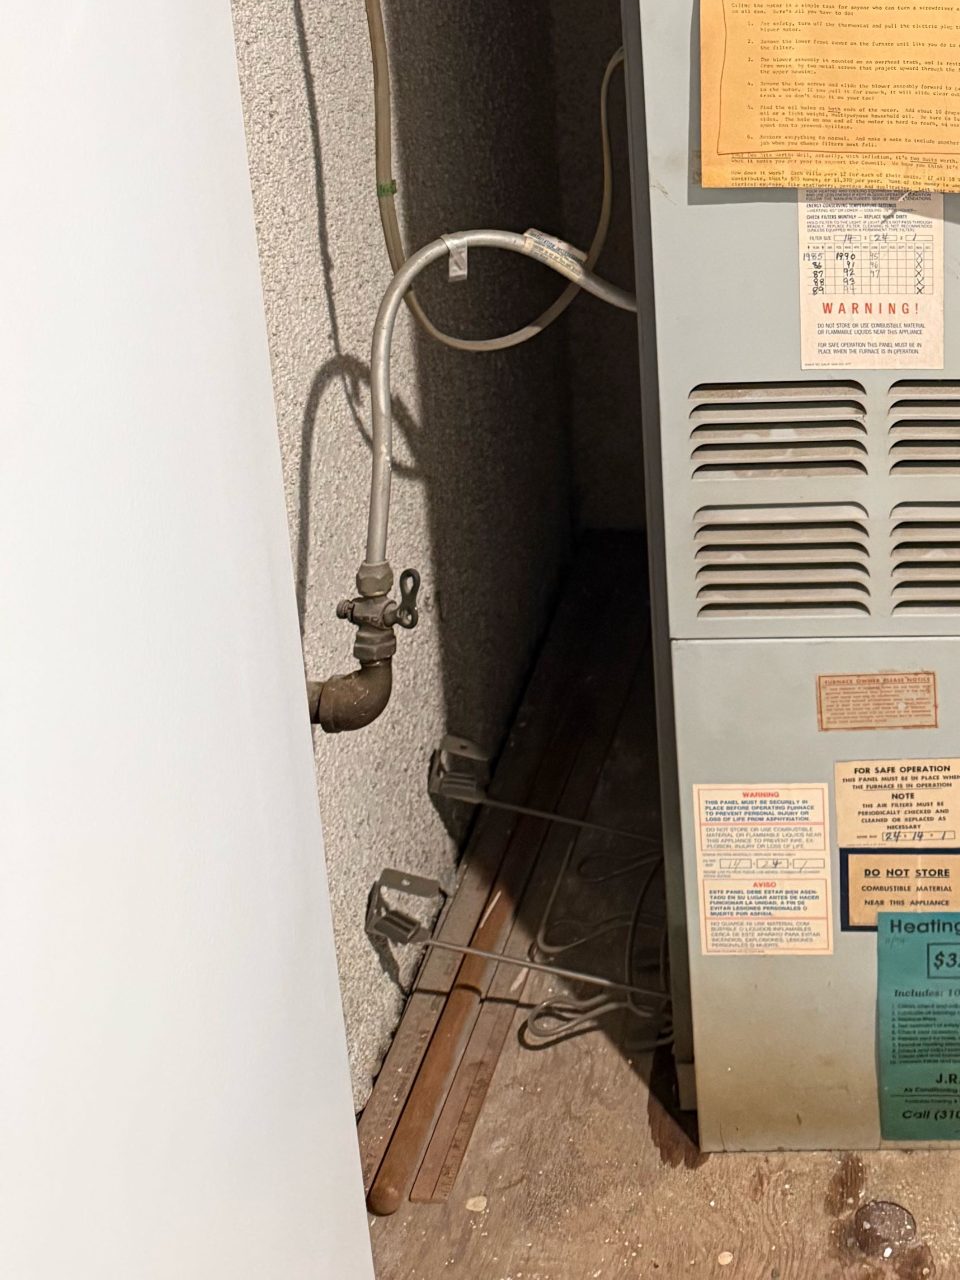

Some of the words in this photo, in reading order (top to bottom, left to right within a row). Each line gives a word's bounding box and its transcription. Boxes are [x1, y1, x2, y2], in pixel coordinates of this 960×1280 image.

[813, 270, 823, 278] 87
[823, 303, 919, 314] WARNING!
[864, 869, 880, 877] DO
[887, 869, 910, 877] NOT
[916, 869, 950, 877] STORE
[894, 989, 943, 998] Includes:
[949, 989, 960, 997] 10
[902, 1109, 930, 1120] Call
